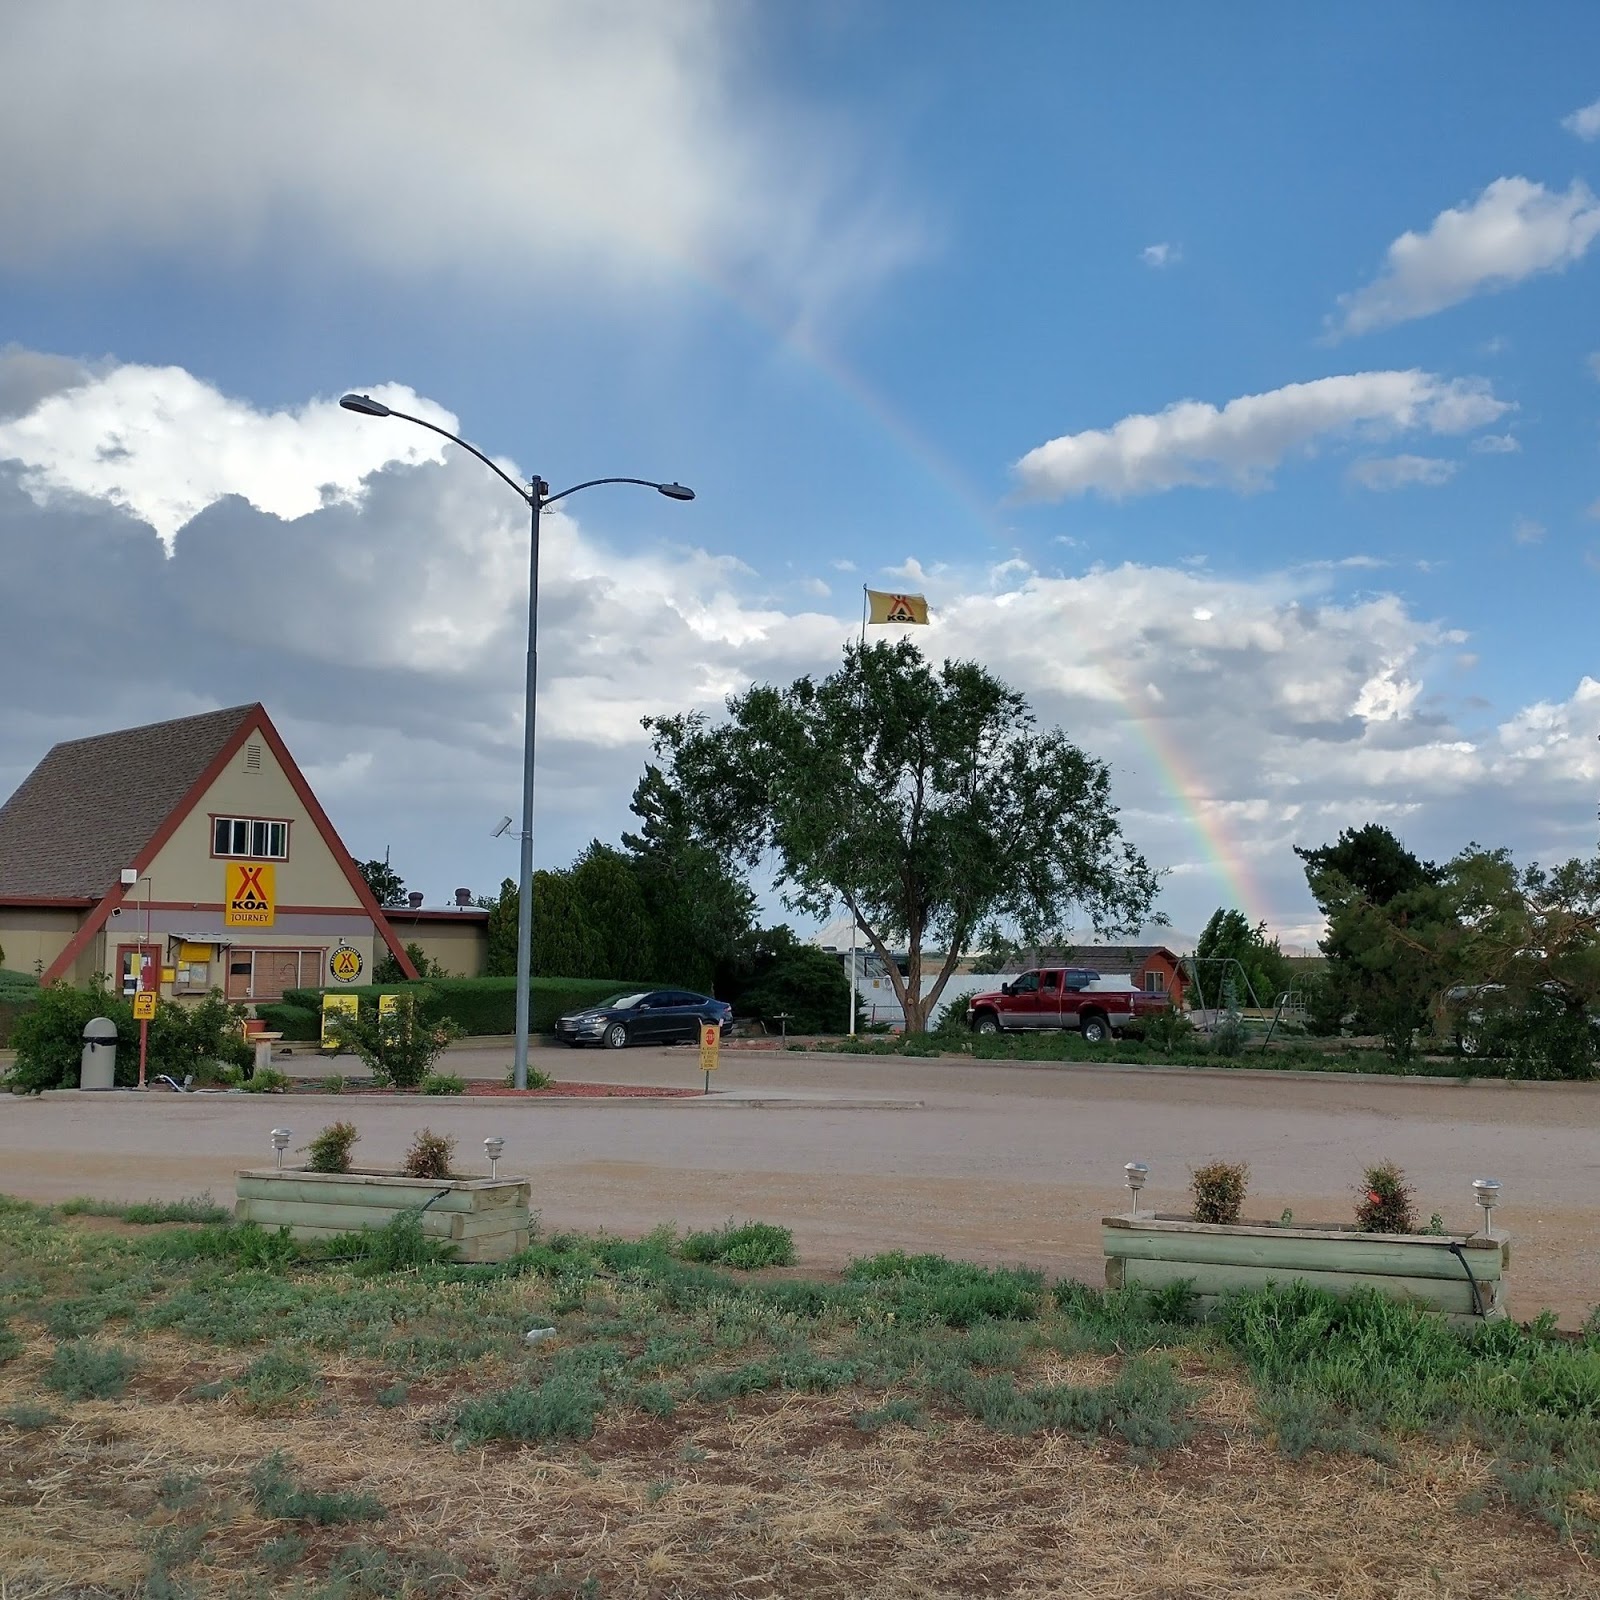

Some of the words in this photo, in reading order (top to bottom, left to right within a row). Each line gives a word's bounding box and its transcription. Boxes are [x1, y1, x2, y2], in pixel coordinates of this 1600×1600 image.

[887, 614, 916, 622] KOA
[232, 901, 268, 910] KOA
[231, 914, 269, 922] JOURNEY
